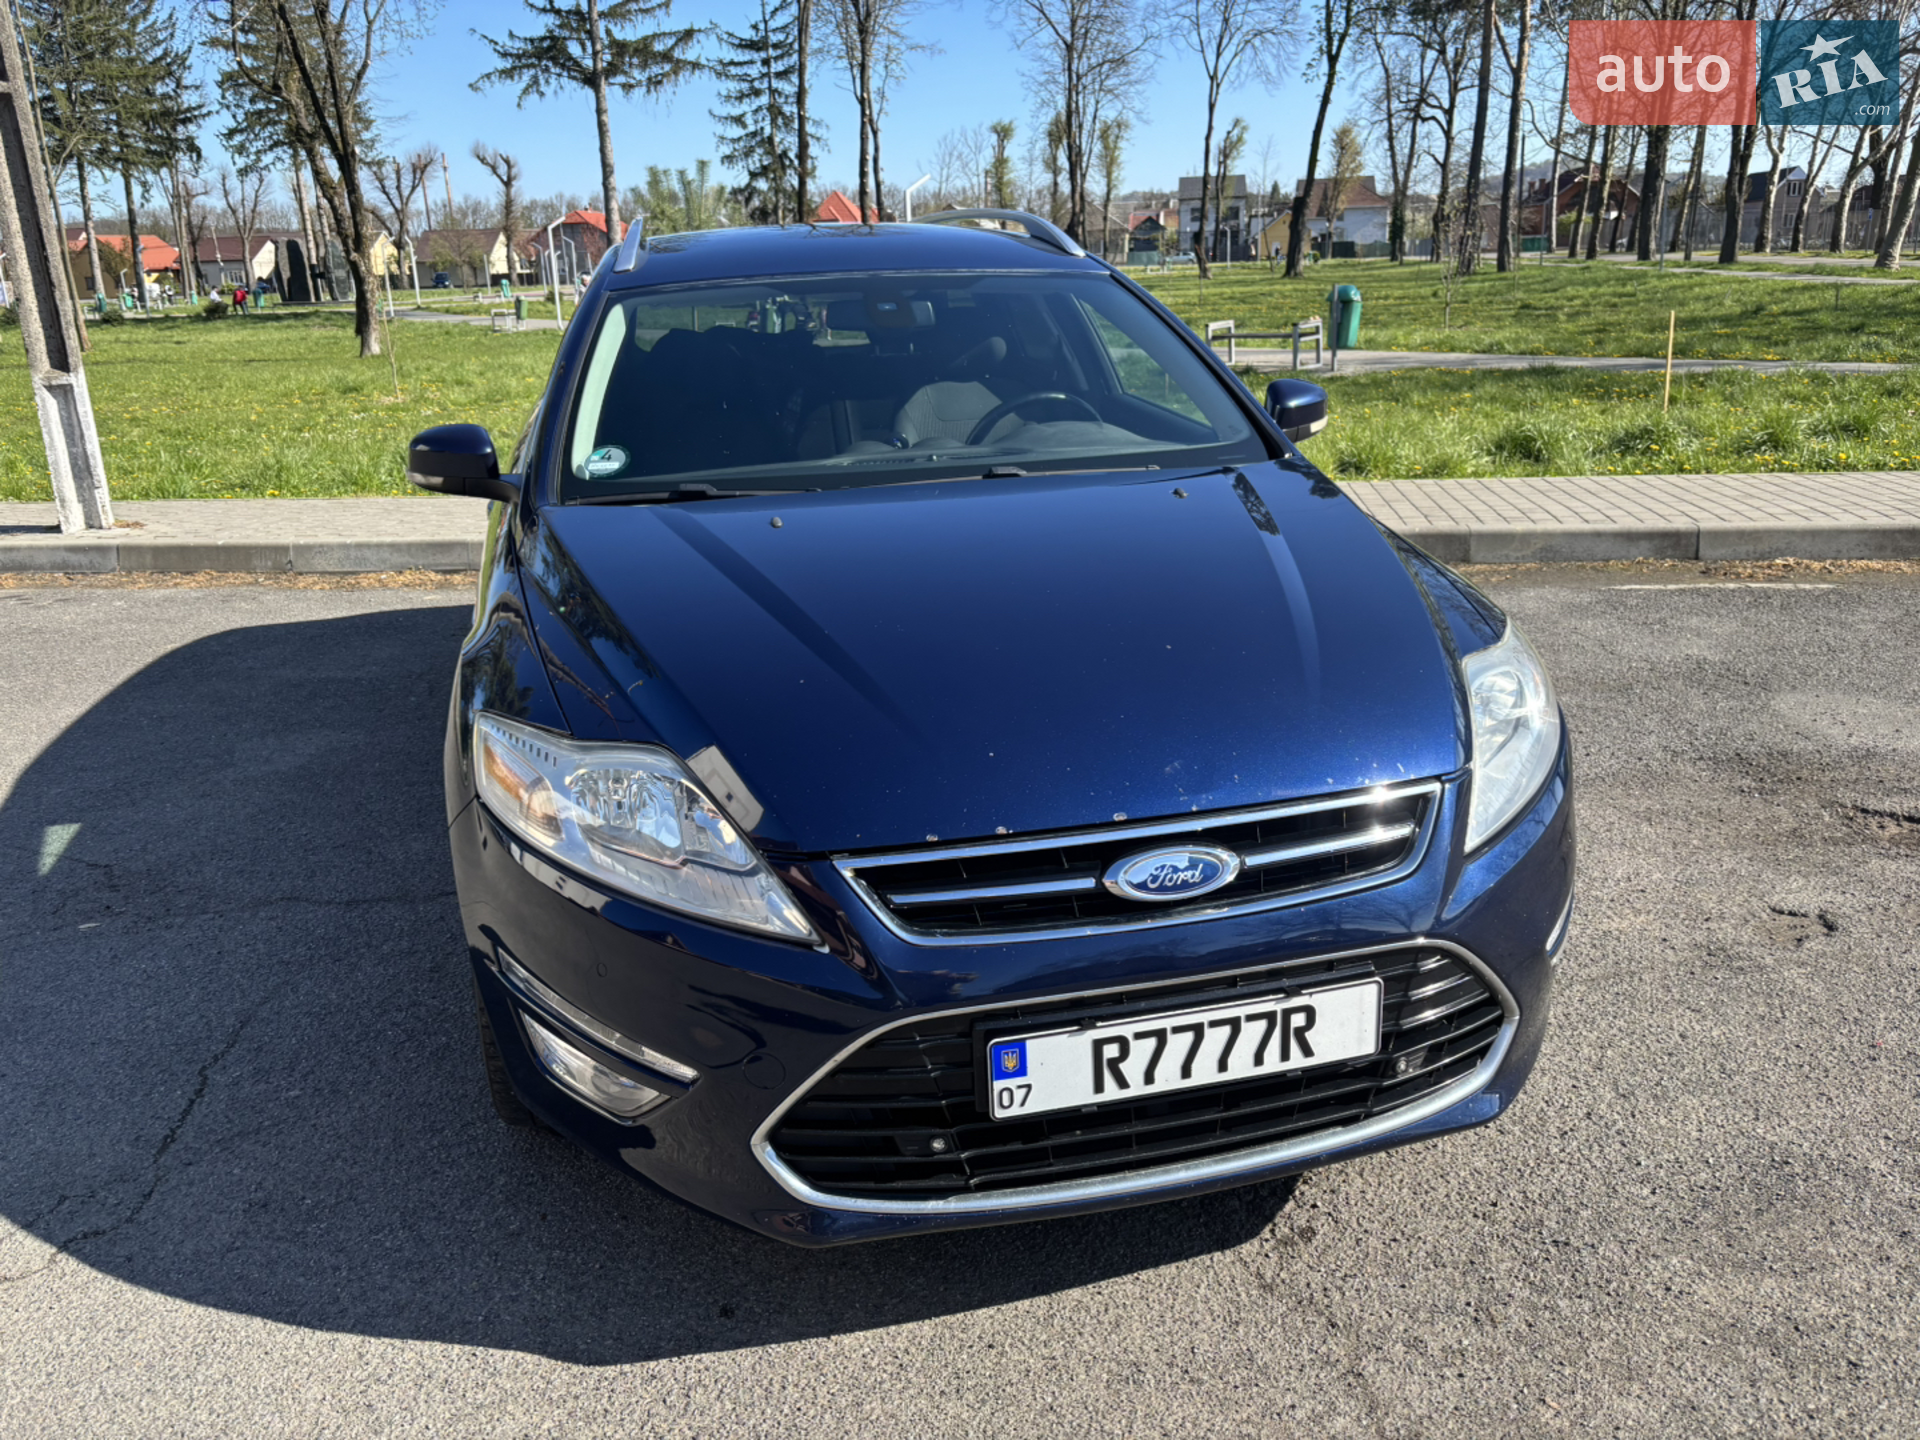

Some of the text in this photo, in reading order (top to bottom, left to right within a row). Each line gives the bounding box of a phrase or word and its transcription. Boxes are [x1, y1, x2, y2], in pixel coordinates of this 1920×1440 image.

[1147, 863, 1203, 889] Ford
[1092, 1003, 1317, 1095] R7777R
[999, 1083, 1033, 1110] 07
